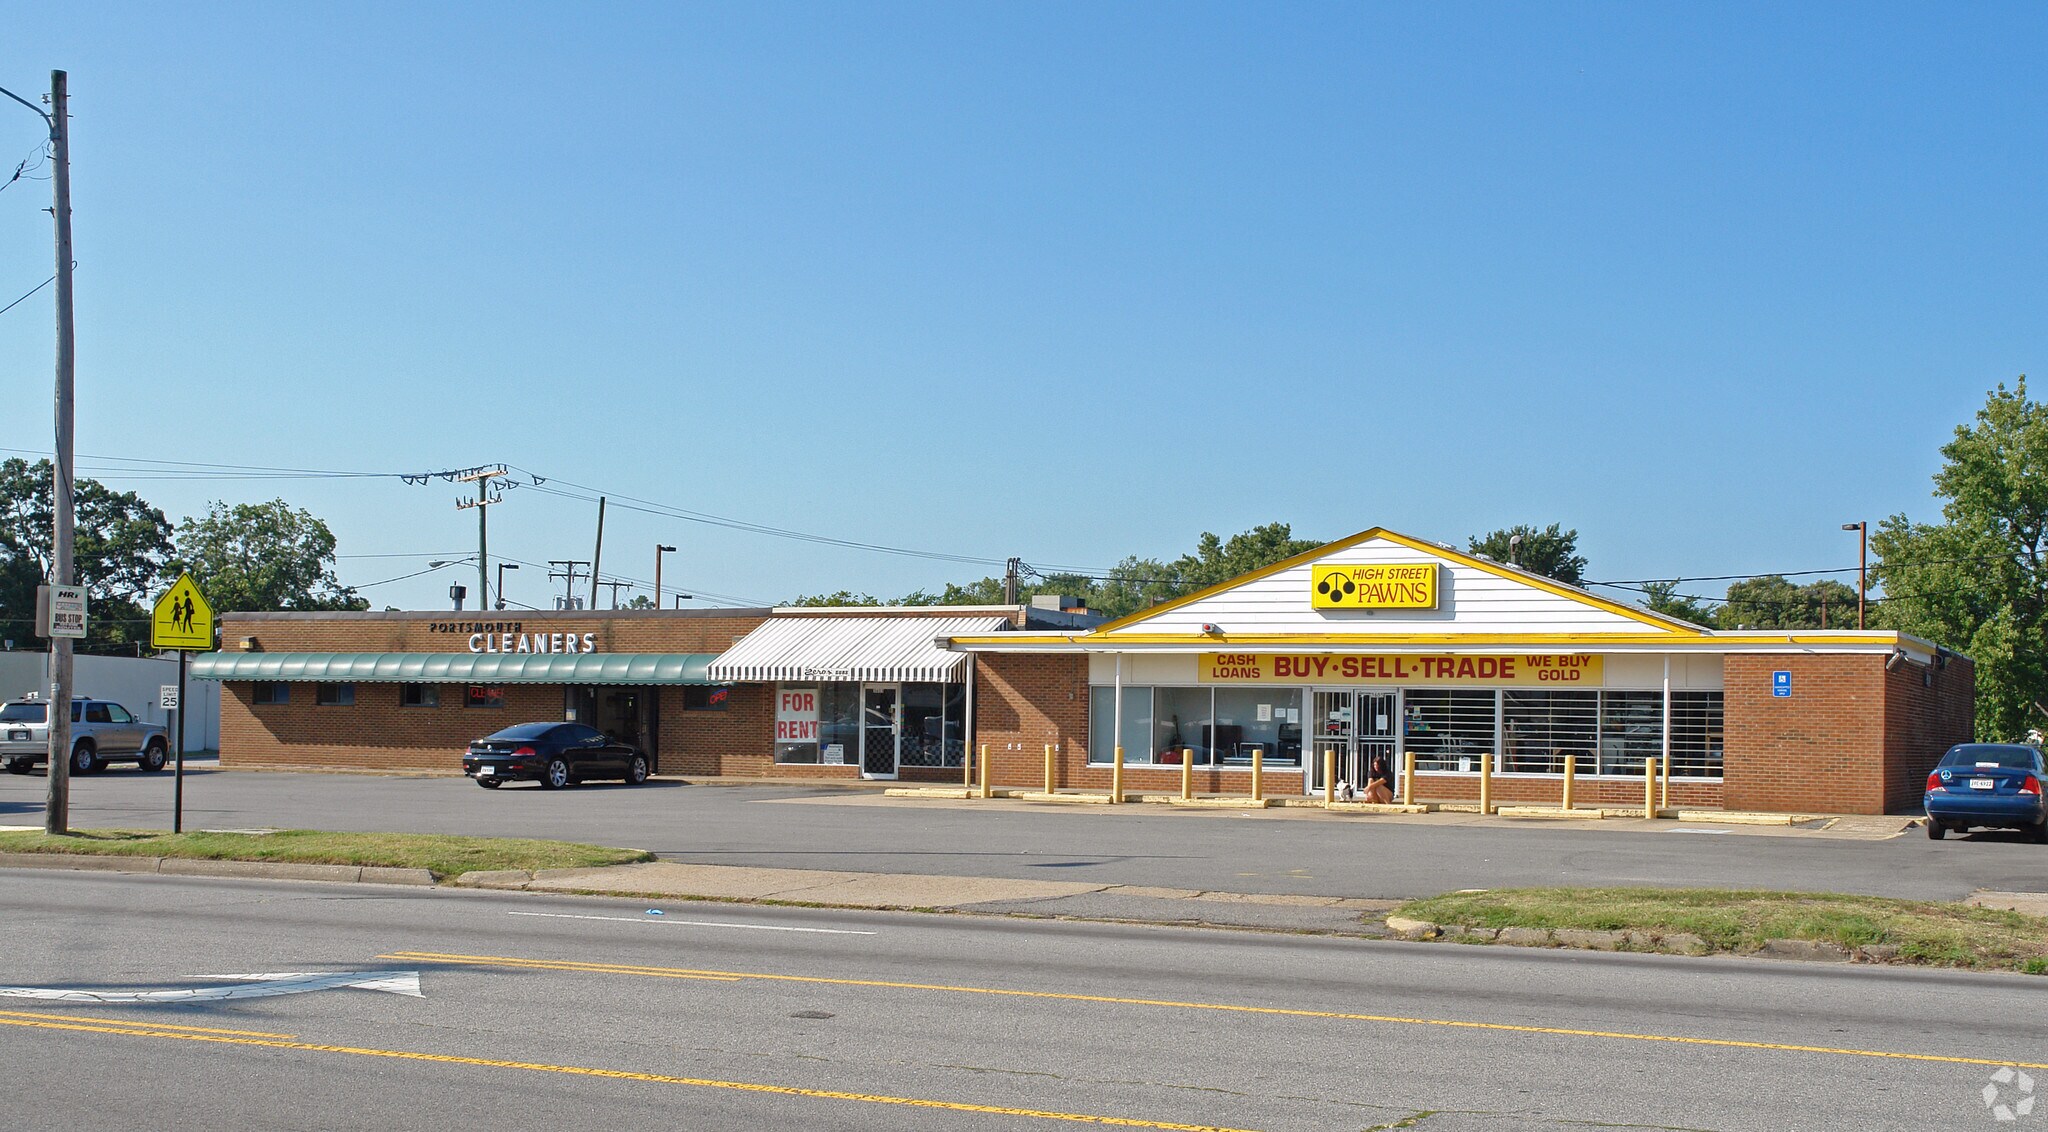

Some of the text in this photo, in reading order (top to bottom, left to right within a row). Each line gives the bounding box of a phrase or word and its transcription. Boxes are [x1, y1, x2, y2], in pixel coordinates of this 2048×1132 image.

[1352, 568, 1429, 580] HIGH STREET
[1357, 582, 1427, 603] PAWNS
[55, 613, 83, 623] BUS STOP
[430, 622, 522, 633] PORTSMOUTH
[468, 633, 597, 653] CLEANERS
[1217, 654, 1256, 666] CASH
[1526, 655, 1591, 667] WE BUY
[1212, 667, 1261, 679] LOANS
[1274, 656, 1516, 679] BUY SELL TRADE
[1538, 669, 1580, 681] GOLD
[162, 697, 177, 706] 25
[782, 693, 814, 712] FOR
[777, 721, 818, 739] RENT
